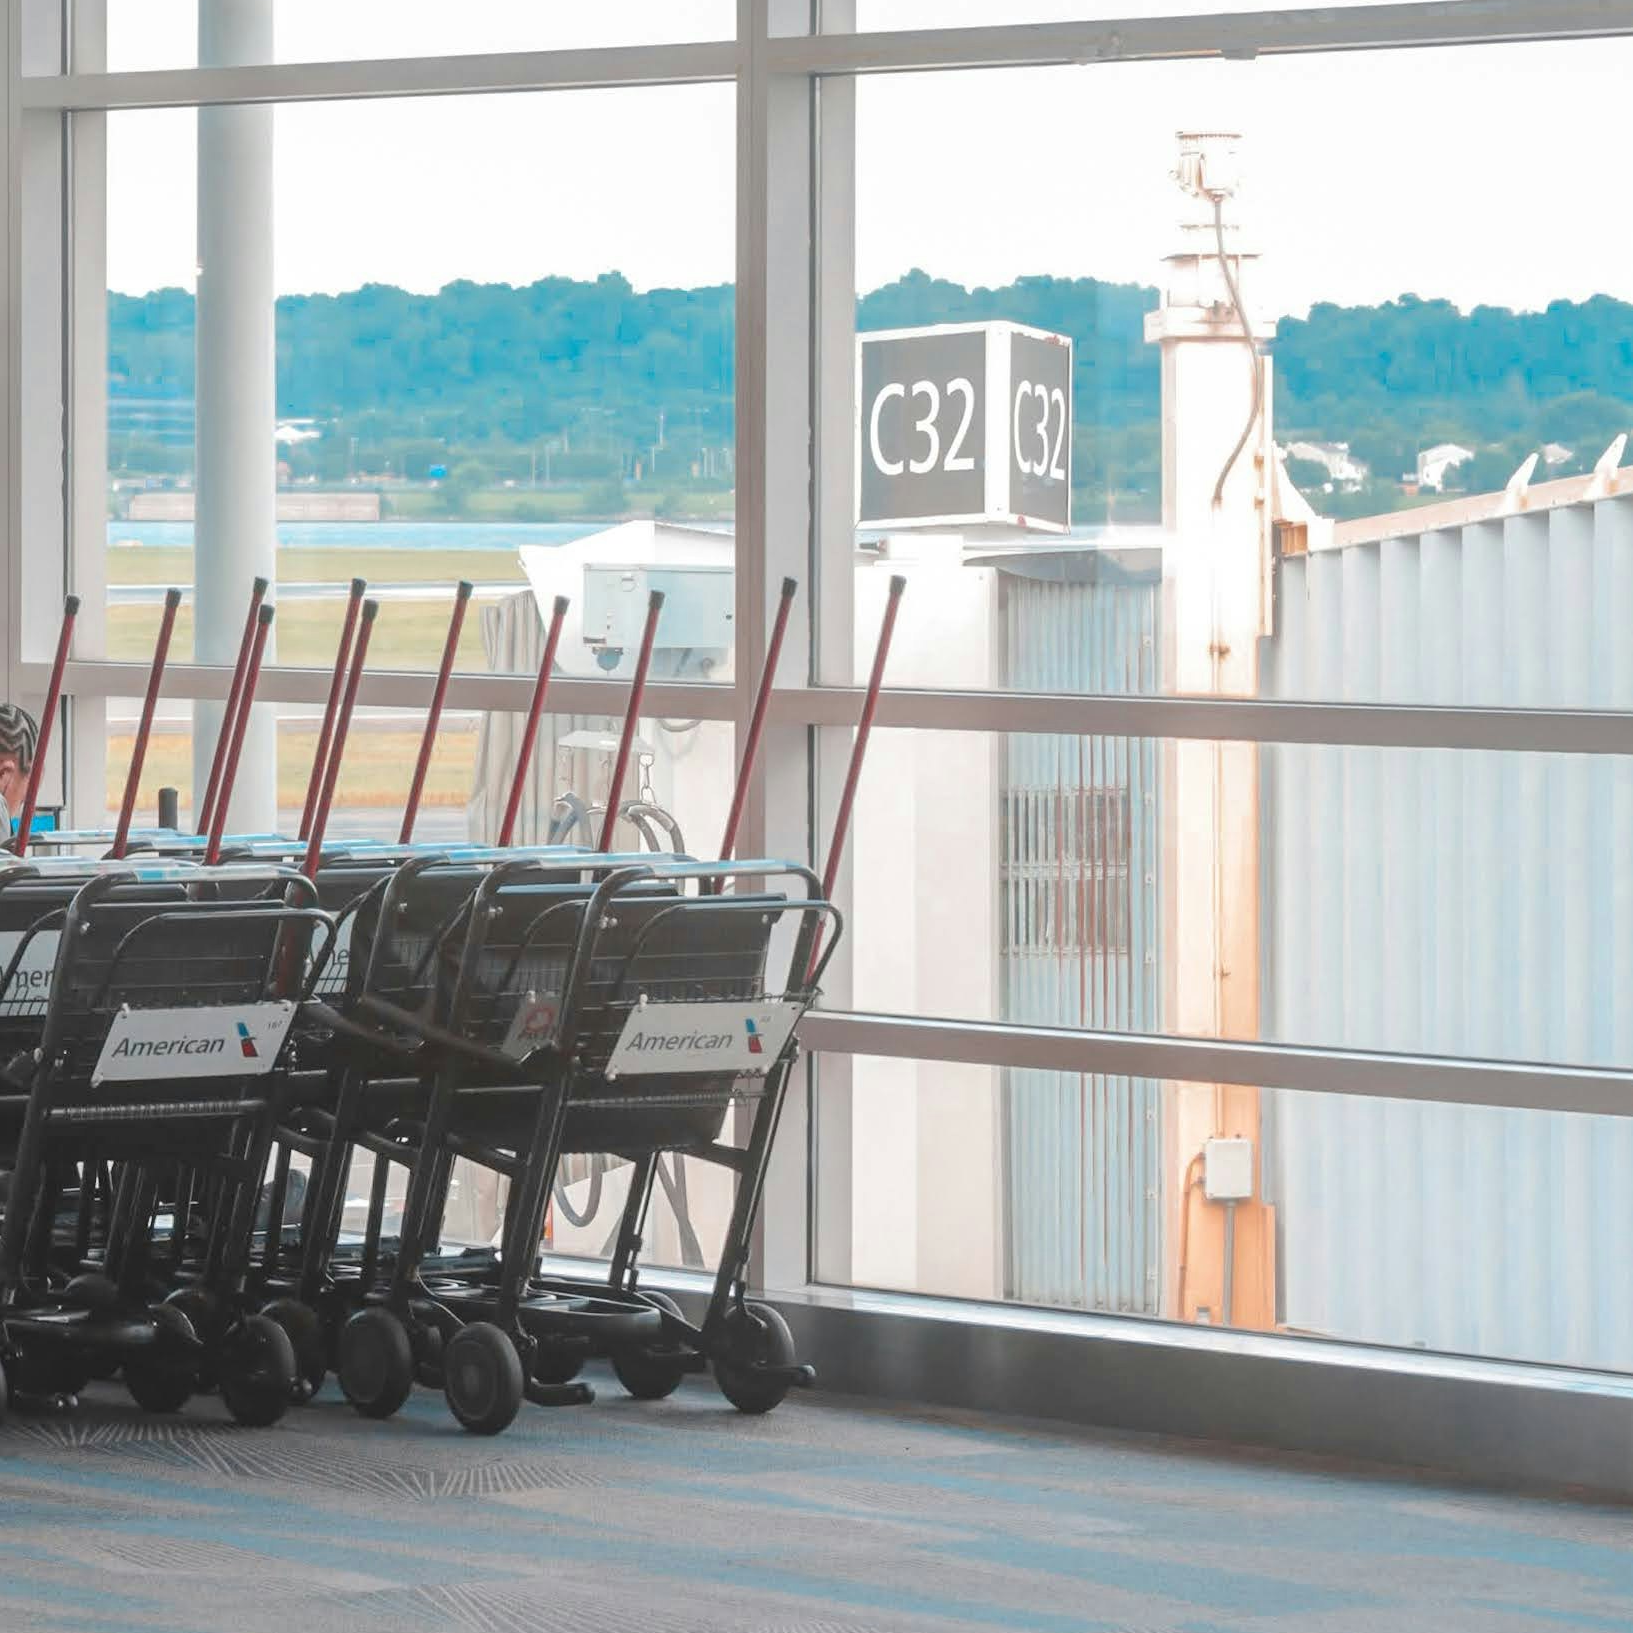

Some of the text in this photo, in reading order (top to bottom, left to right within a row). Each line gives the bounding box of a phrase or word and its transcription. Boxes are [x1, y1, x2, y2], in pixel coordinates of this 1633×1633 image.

[870, 377, 975, 476] C32
[1013, 379, 1066, 481] C32
[111, 1035, 226, 1058] American
[625, 1030, 734, 1052] American
